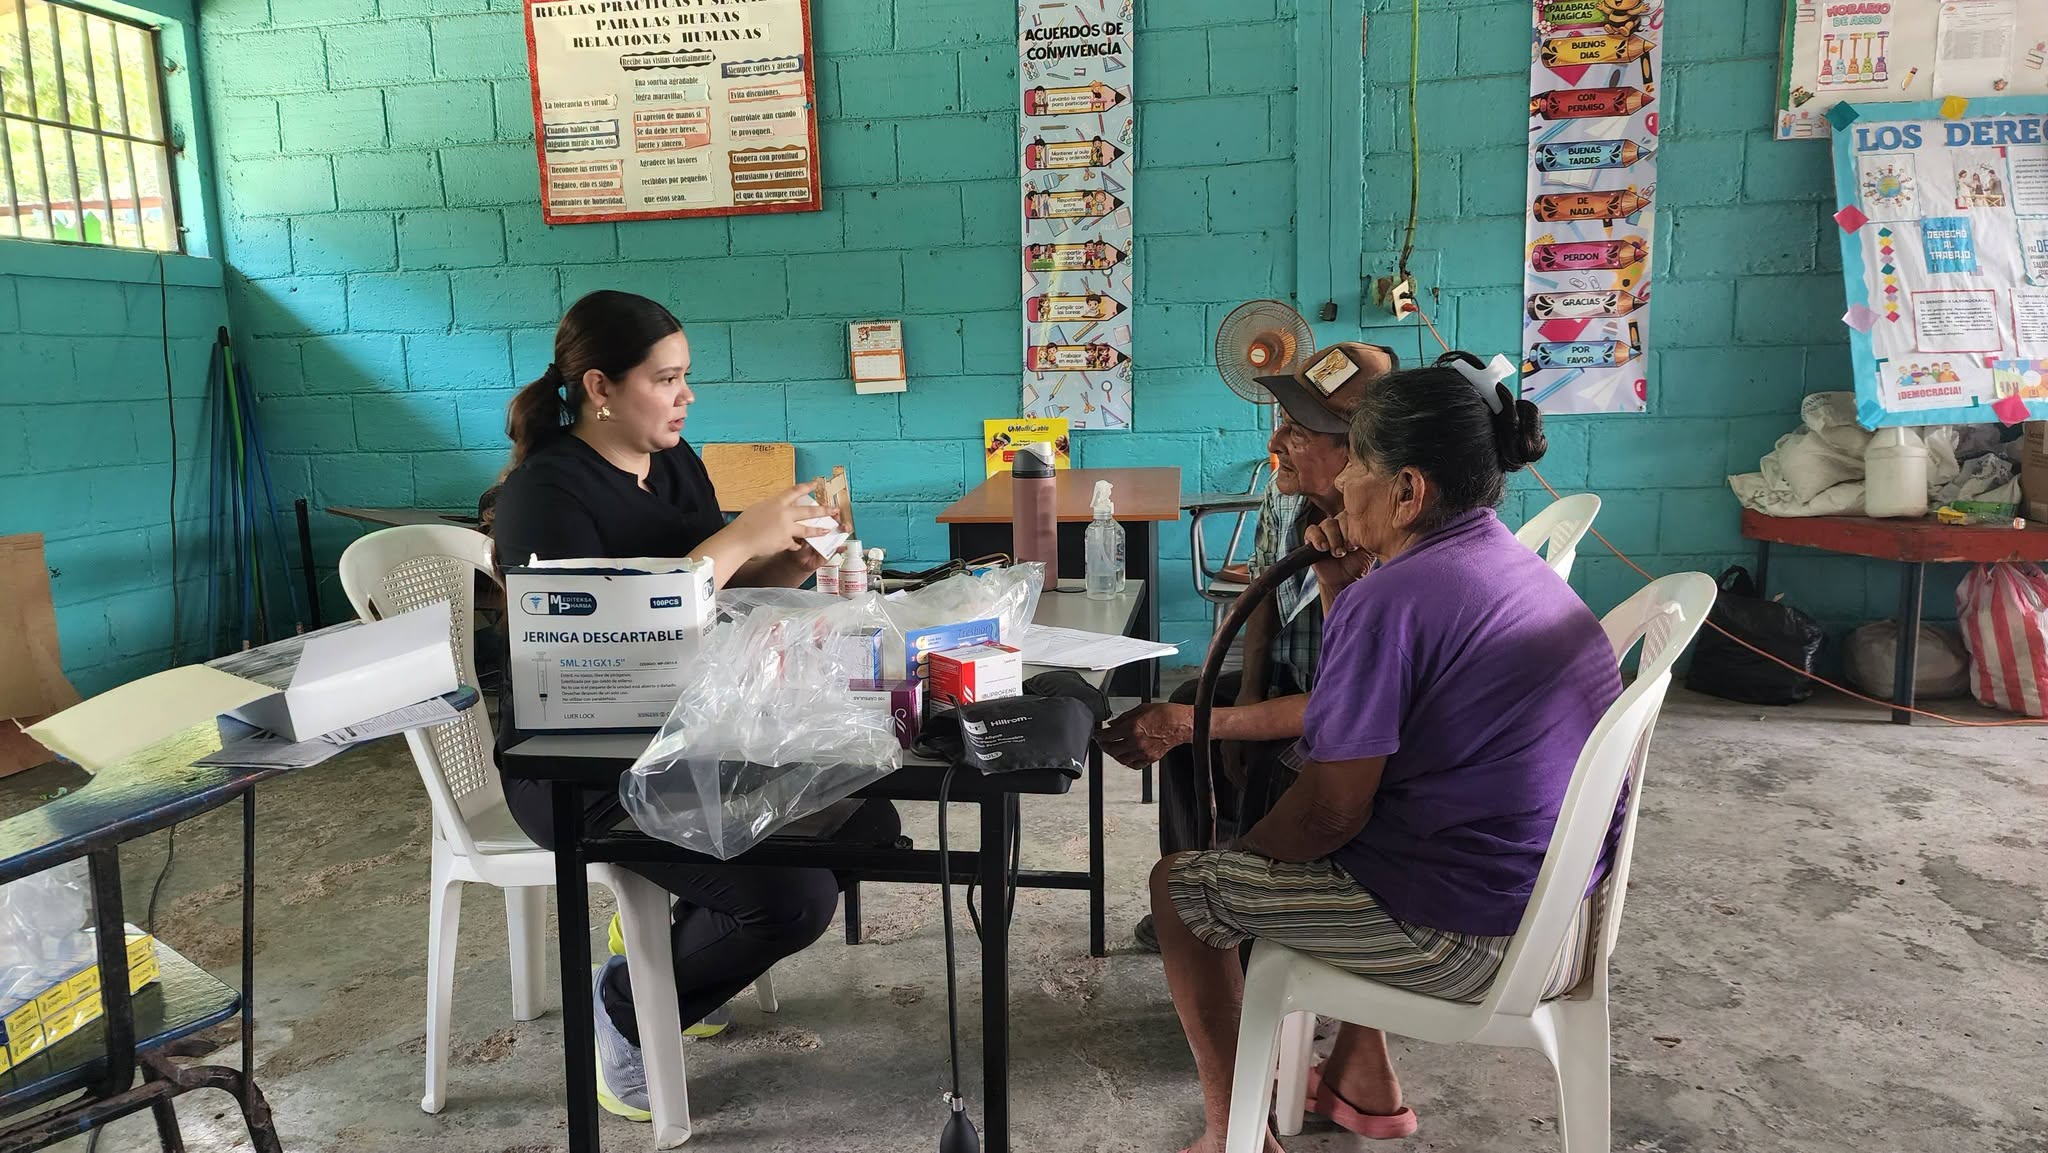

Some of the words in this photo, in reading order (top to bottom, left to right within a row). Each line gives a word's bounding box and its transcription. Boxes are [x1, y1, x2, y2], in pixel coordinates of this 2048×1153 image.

[535, 4, 595, 18] REGLAS
[1550, 2, 1596, 12] PALABRAS
[1827, 3, 1891, 17] HORARIO
[1551, 11, 1593, 21] MAGICAS
[596, 17, 640, 31] PARA
[643, 15, 671, 28] LAS
[678, 11, 741, 25] BUENAS
[1833, 17, 1848, 27] DE
[1850, 15, 1882, 26] ASEO
[1025, 24, 1101, 41] ACUERDOS
[1105, 22, 1124, 36] DE
[573, 33, 672, 48] RELACIONES
[682, 28, 762, 43] HUMANAS
[1571, 40, 1606, 49] BUENOS
[1026, 42, 1122, 60] CONVIVENCIA
[1580, 51, 1600, 60] DIAS
[647, 78, 668, 86] sonrisa
[668, 77, 698, 86] agradable
[635, 93, 652, 101] logra
[730, 91, 745, 99] Evita
[1577, 93, 1596, 102] CON
[553, 100, 583, 109] tolerancia
[1568, 103, 1605, 112] PERMISO
[775, 110, 797, 119] cuando
[547, 126, 569, 134] Cuando
[645, 127, 652, 135] da
[1856, 124, 1922, 152] LOS
[1944, 119, 2048, 147] DERE
[1568, 146, 1602, 155] BUENAS
[640, 159, 666, 168] Agradece
[734, 155, 757, 163] Coopera
[1568, 156, 1601, 165] TARDES
[641, 177, 668, 186] recibidos
[735, 173, 768, 181] entusiasmo
[598, 180, 614, 188] signo
[743, 192, 754, 200] que
[764, 190, 788, 199] siempre
[789, 189, 807, 197] recibe
[550, 199, 583, 207] admirables
[644, 196, 655, 204] que
[1577, 197, 1589, 205] DE
[1569, 207, 1595, 216] NADA
[1927, 230, 1968, 239] DERECHO
[1943, 241, 1955, 249] AL
[1563, 252, 1600, 262] PERDON
[1929, 251, 1972, 260] TRABAJO
[1562, 298, 1601, 307] GRACIAS
[1571, 346, 1590, 354] POR
[1567, 356, 1595, 365] FAVOR
[1897, 386, 1963, 401] ¡DEMOCRACIA!
[652, 599, 680, 607] 100PCS
[522, 630, 578, 643] JERINGA
[583, 629, 684, 643] DESCARTABLE
[560, 659, 580, 667] 5ML
[990, 716, 1028, 727] Hillrom
